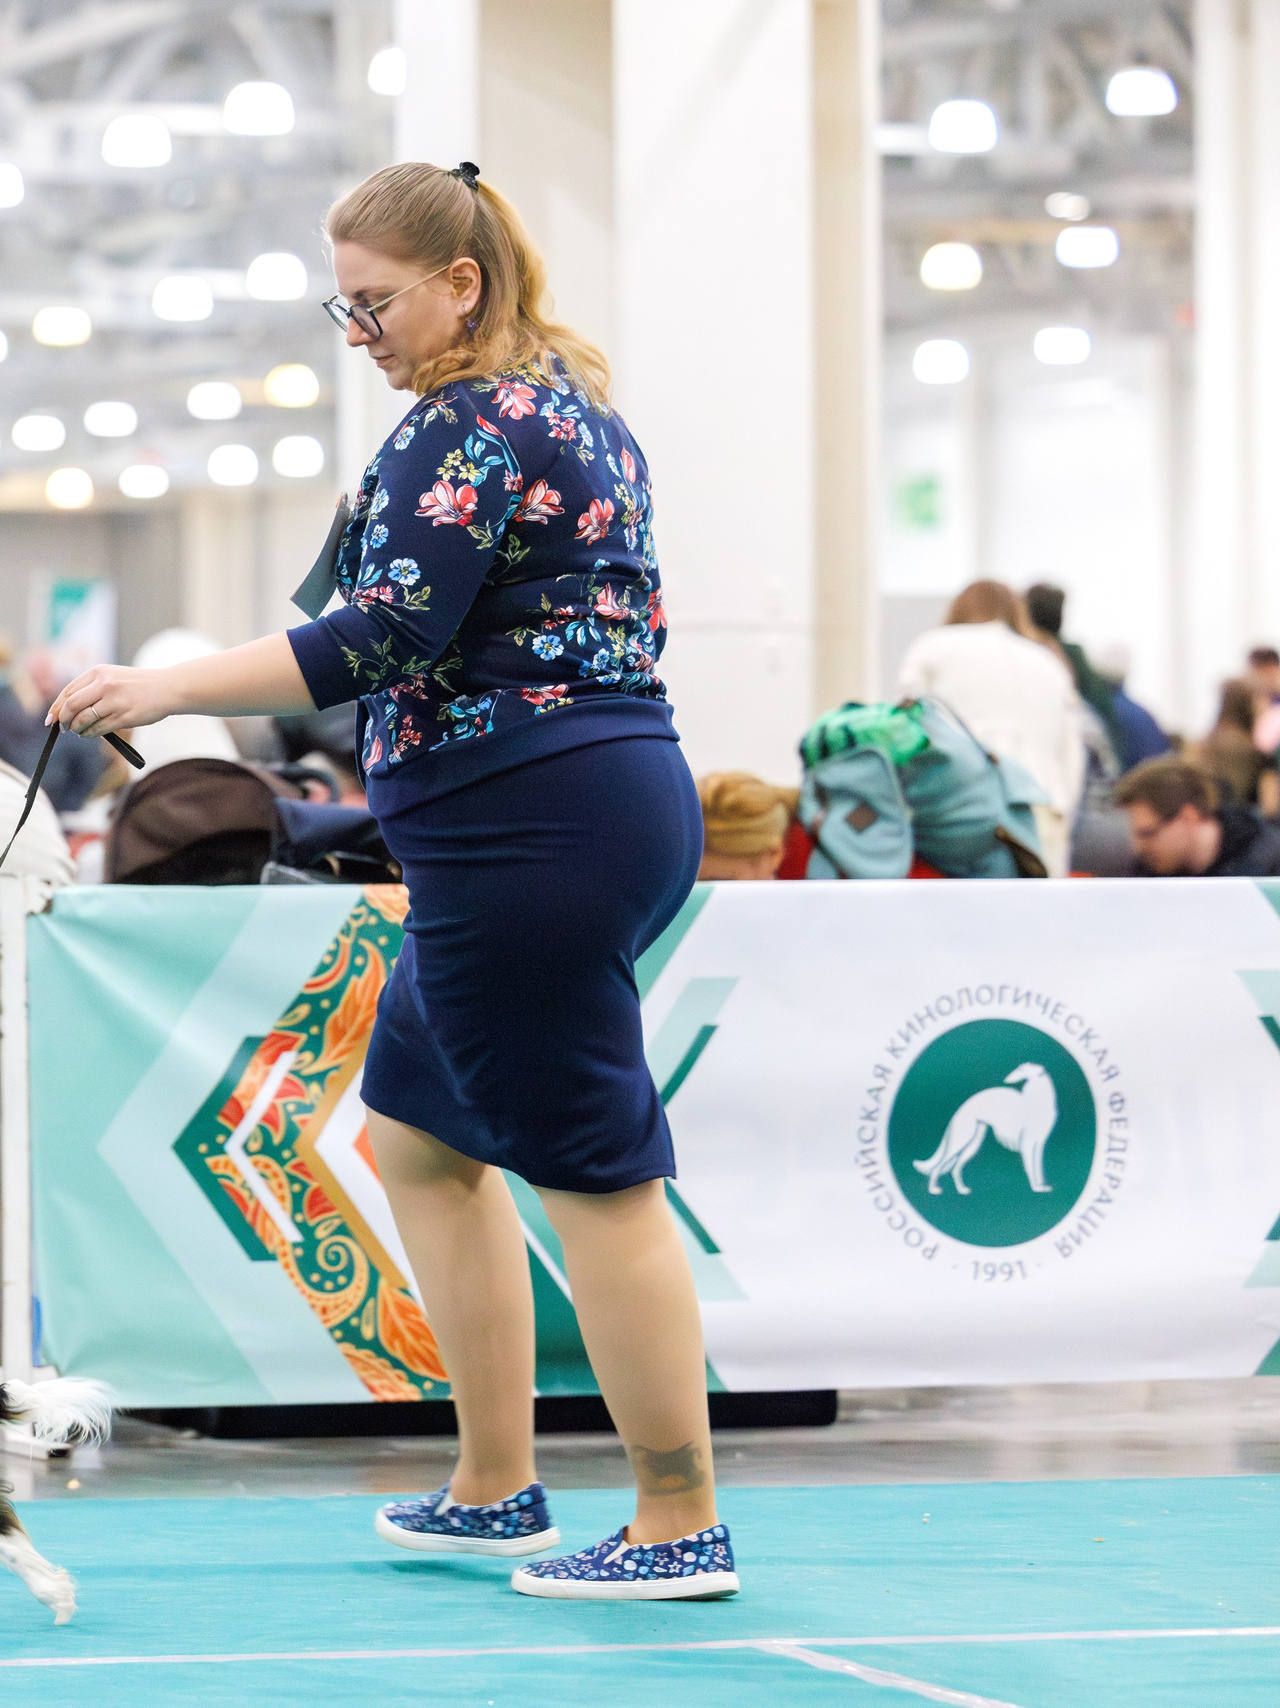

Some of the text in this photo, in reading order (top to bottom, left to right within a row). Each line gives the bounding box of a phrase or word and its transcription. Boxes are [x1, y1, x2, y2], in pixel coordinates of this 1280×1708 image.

[854, 984, 1128, 1261] РОССИЙСКАЯ КИНОЛОГИЧЕСКАЯ ФЕДЕРАЦИЯ
[972, 1259, 1028, 1282] 1991
